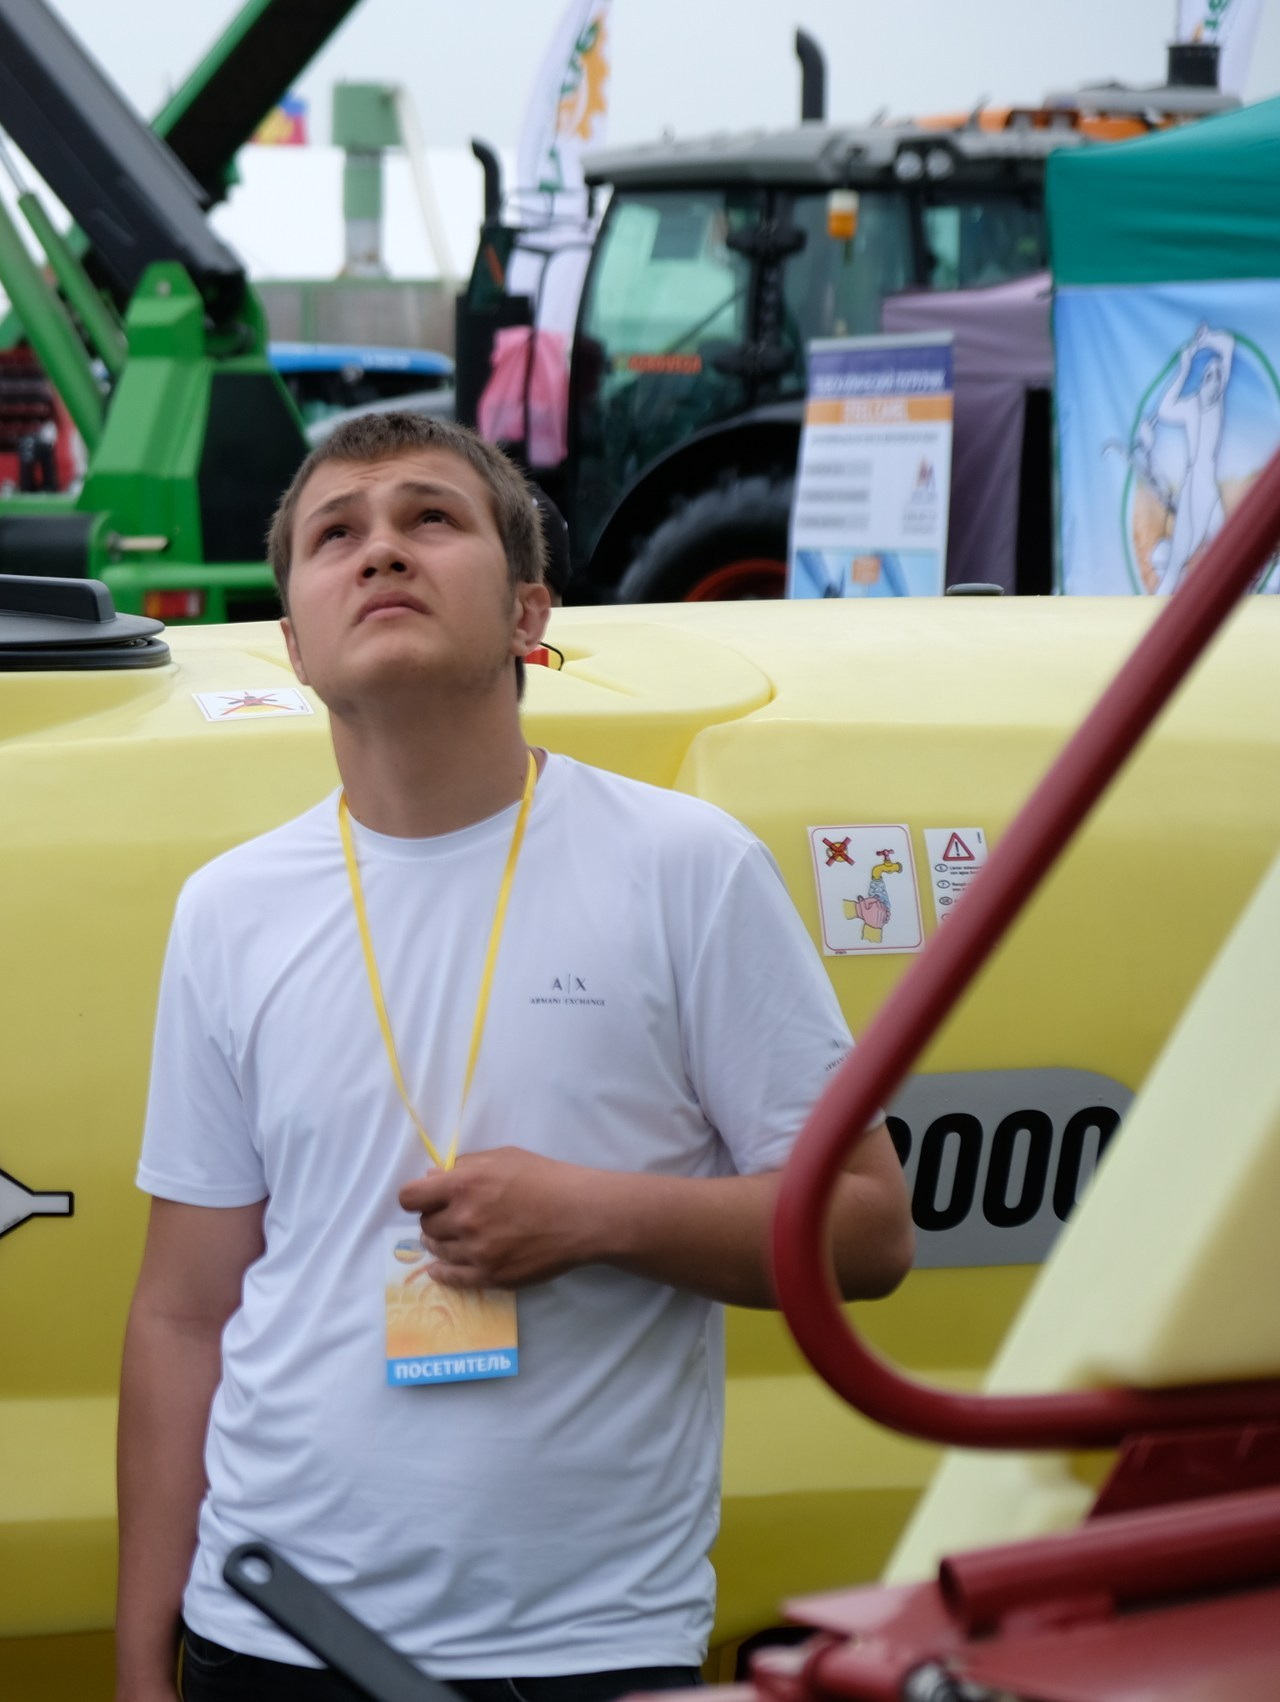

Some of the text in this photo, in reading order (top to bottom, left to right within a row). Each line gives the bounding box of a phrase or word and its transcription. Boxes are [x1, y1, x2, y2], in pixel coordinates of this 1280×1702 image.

[565, 998, 605, 1006] EXCHANGE
[885, 1106, 1122, 1231] 000
[395, 1354, 512, 1380] ПОСЕТИТЕЛЬ
